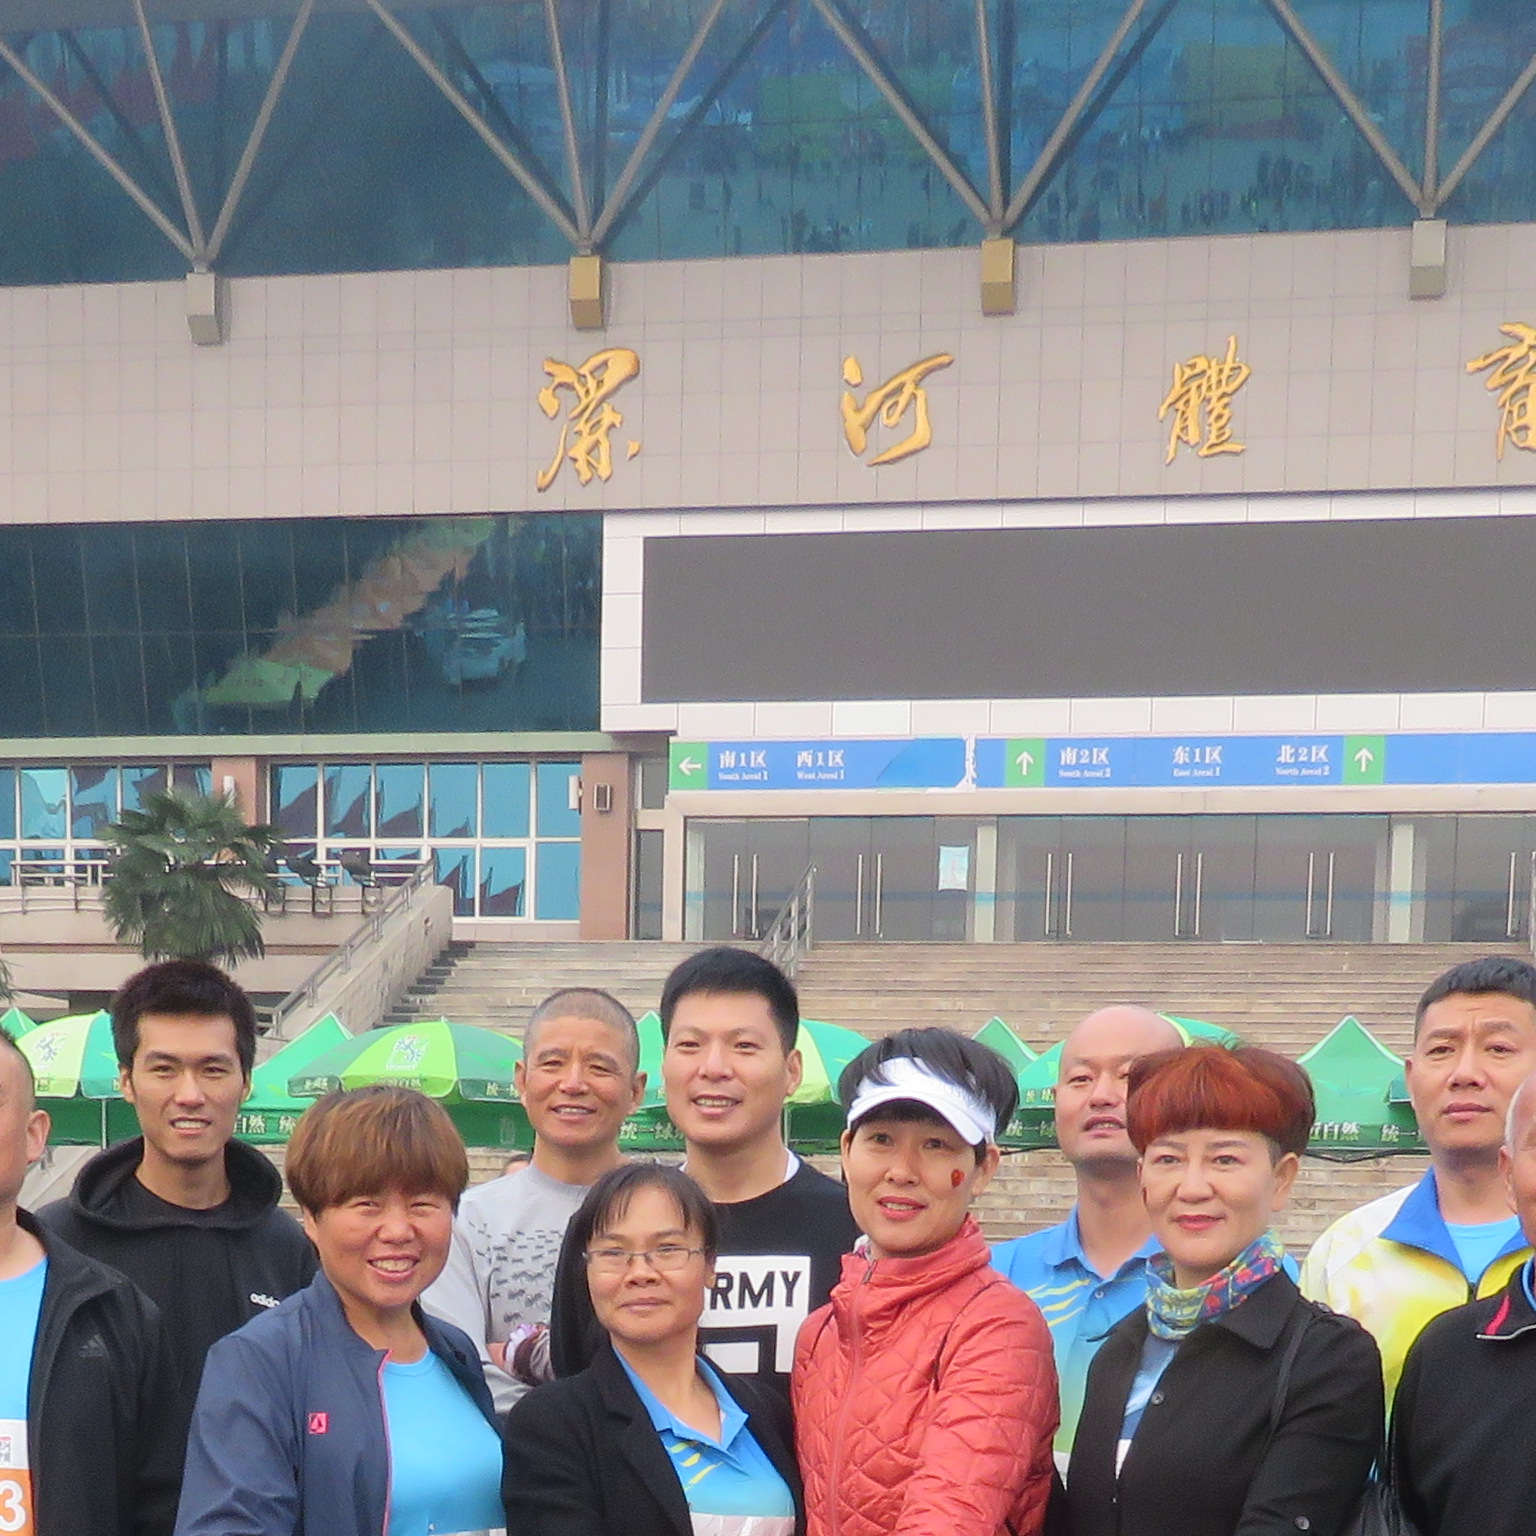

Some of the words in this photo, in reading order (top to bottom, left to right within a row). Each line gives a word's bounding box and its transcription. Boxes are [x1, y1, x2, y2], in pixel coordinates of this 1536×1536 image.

[719, 750, 767, 769] 南1区
[797, 750, 845, 768] 西1区
[1060, 747, 1109, 765] 南2区
[1173, 746, 1223, 764] 东1区
[1276, 744, 1329, 763] 北2区
[710, 1271, 801, 1310] RMY
